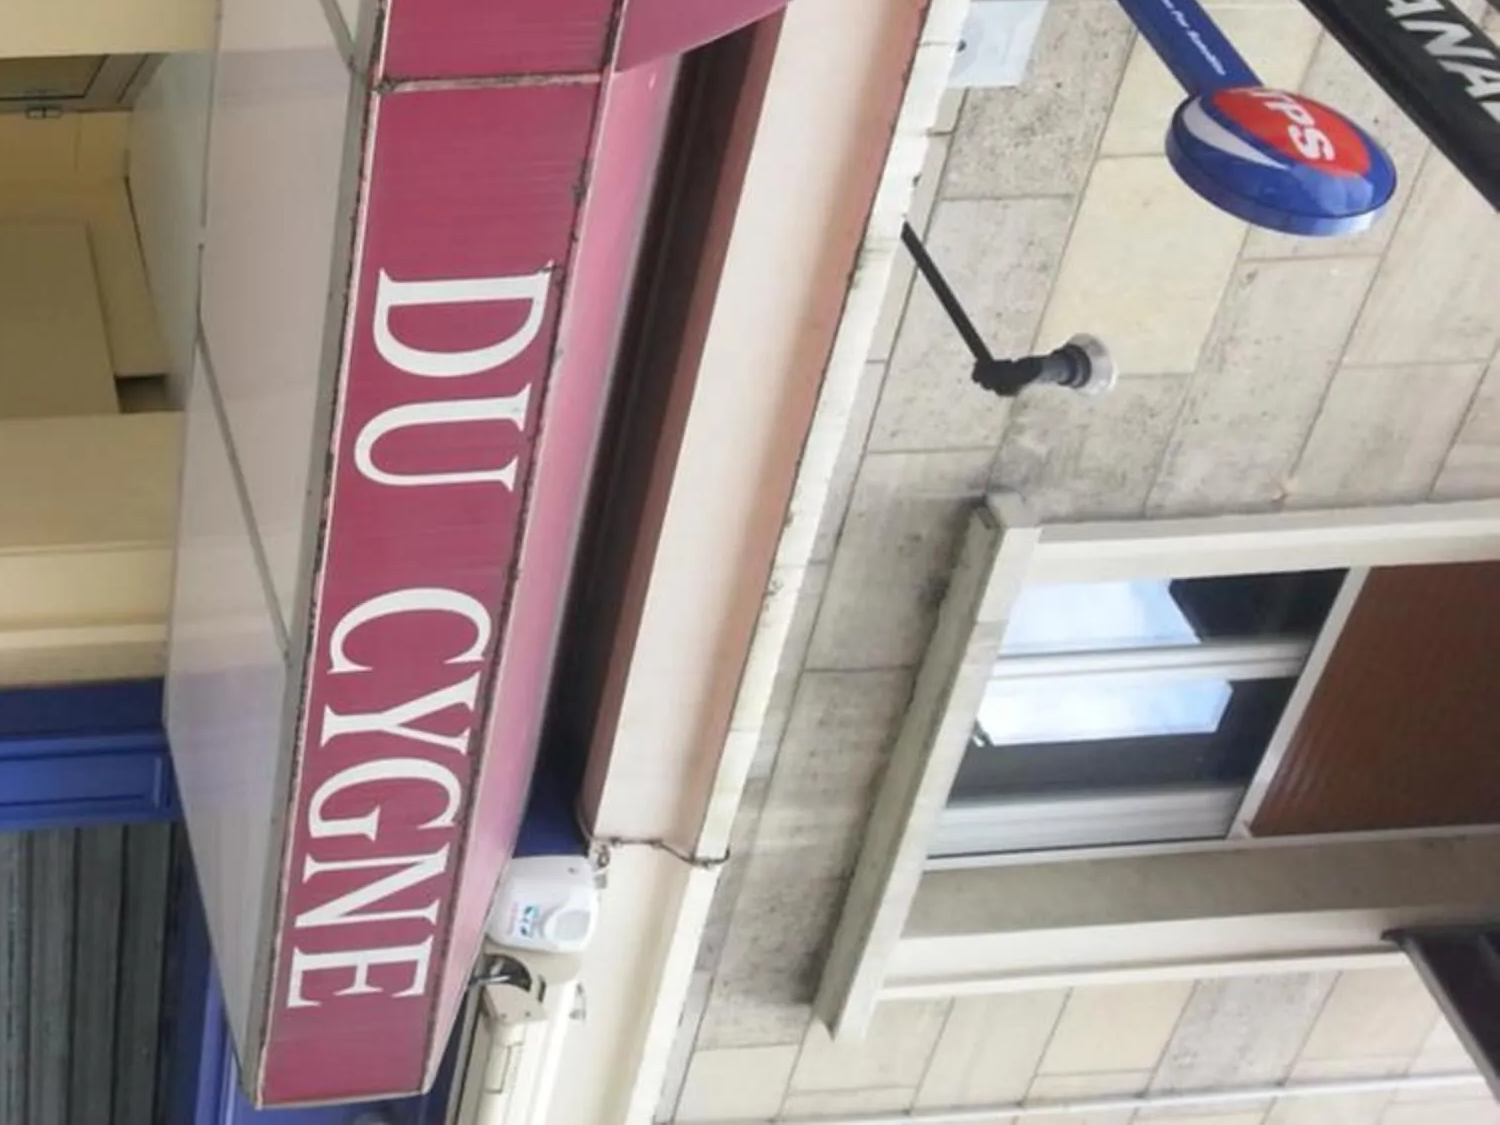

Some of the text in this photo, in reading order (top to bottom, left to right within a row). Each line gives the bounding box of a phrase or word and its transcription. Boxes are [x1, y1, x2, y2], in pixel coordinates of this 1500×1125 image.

[1252, 91, 1336, 161] TPS
[287, 259, 553, 1008] DU CYGNE
